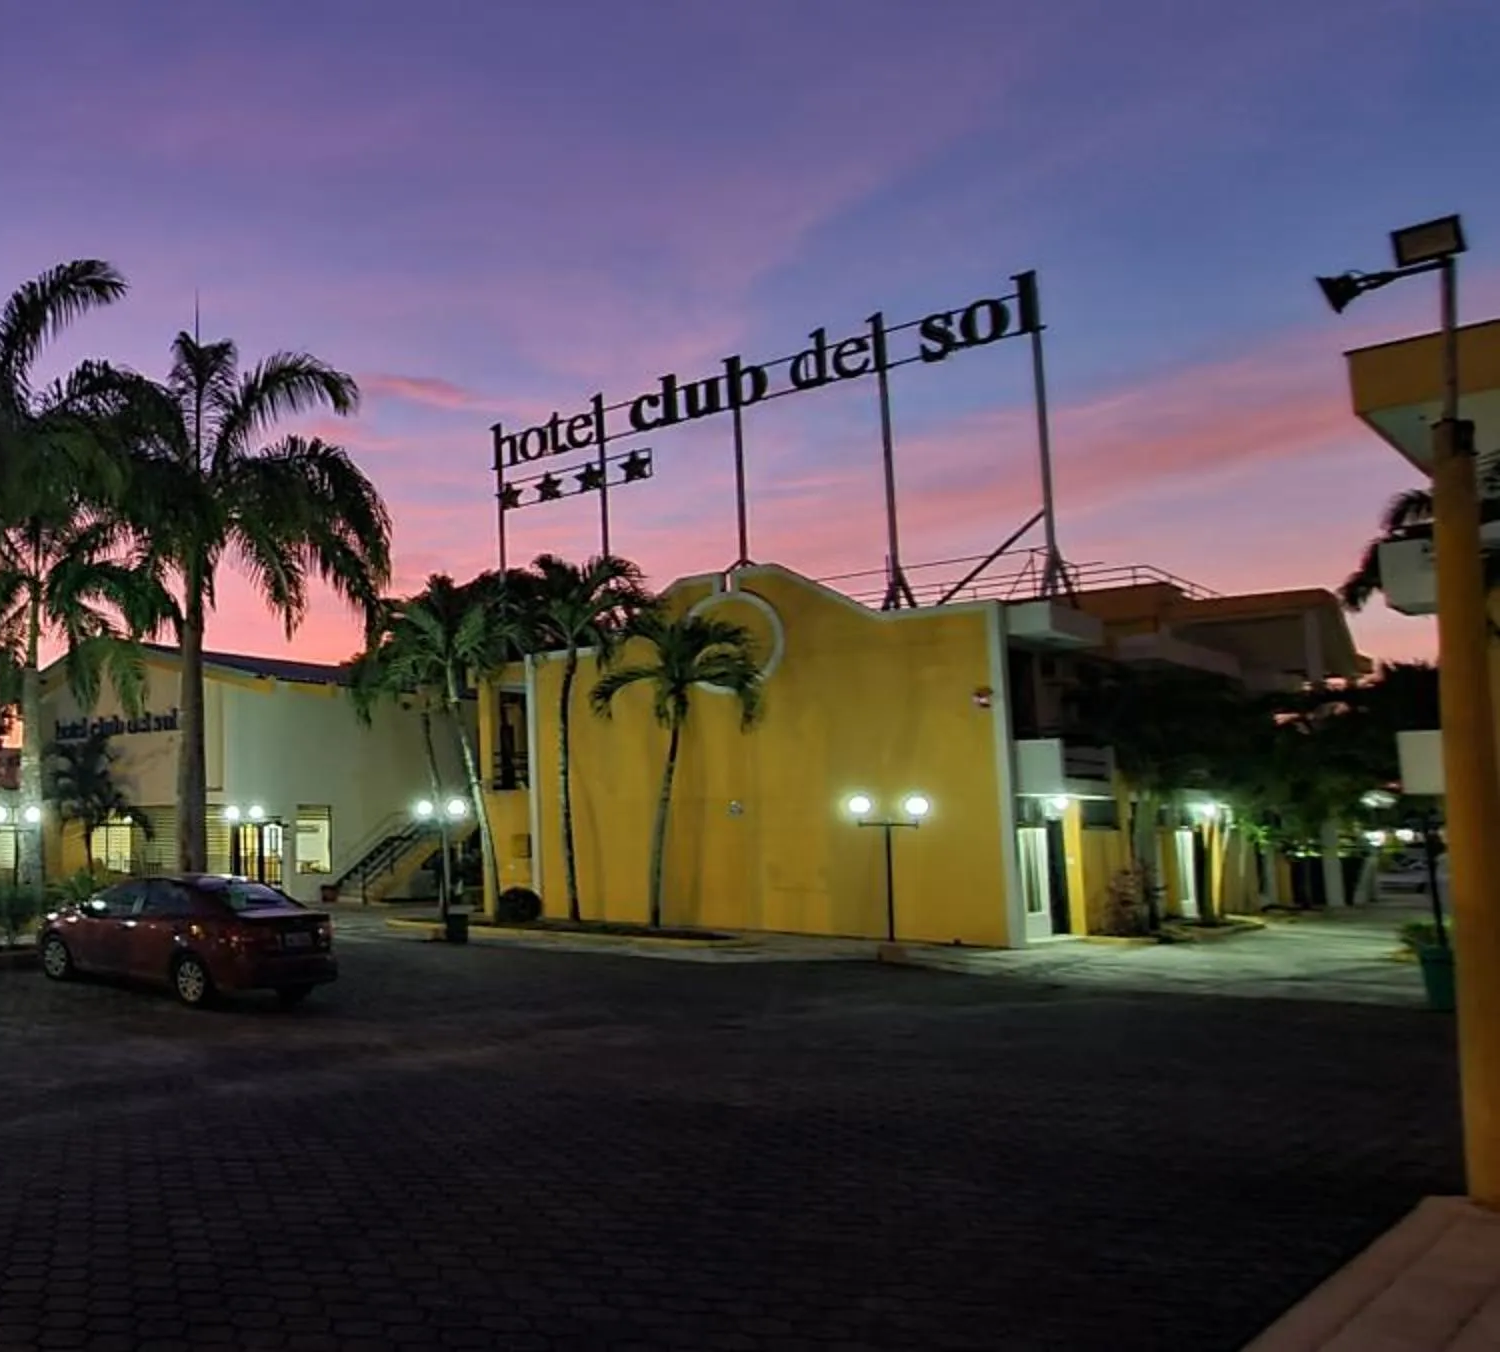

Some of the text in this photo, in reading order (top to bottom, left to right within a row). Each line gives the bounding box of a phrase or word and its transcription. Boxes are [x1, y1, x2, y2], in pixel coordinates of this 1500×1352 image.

[490, 270, 1046, 470] hotel club del sol
